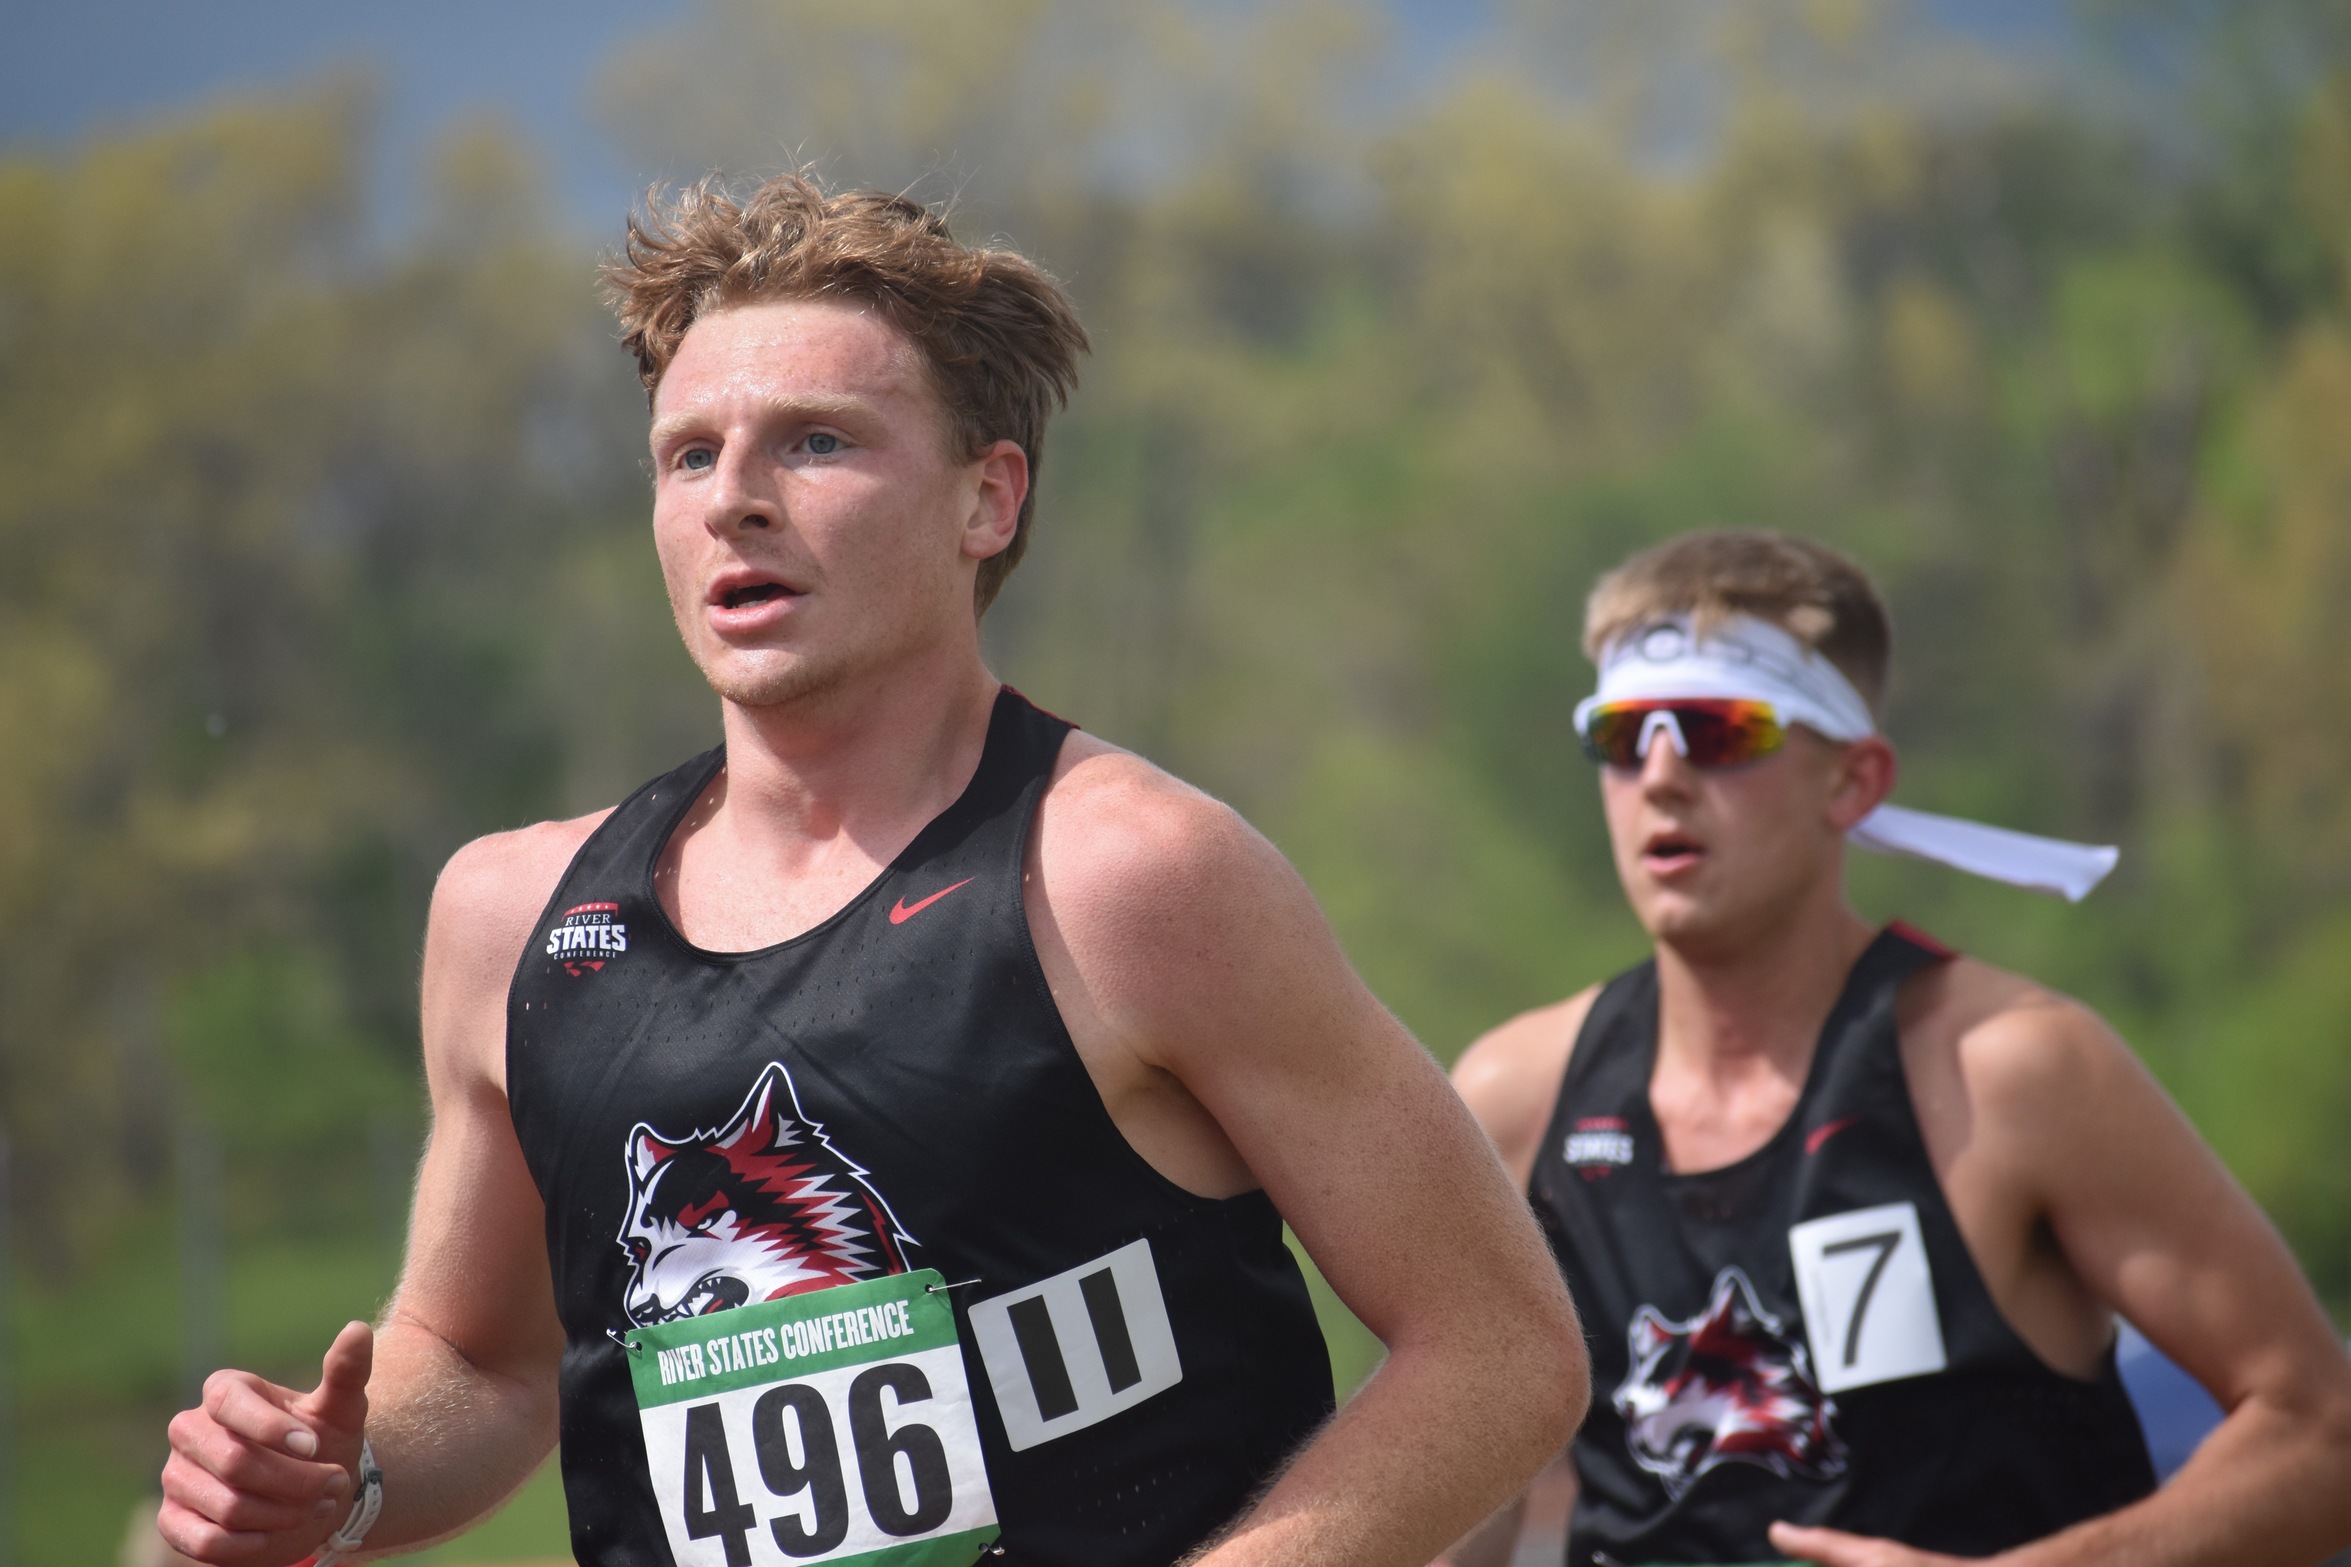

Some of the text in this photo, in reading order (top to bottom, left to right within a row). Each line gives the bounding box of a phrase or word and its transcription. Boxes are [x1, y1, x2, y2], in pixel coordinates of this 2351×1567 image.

[546, 924, 627, 955] STATES
[565, 913, 611, 926] RIVER
[553, 951, 617, 960] CONFERENCE
[1822, 1230, 1903, 1368] 7
[657, 1299, 915, 1386] RIVER STATES CONFERENCE
[683, 1362, 954, 1567] 496
